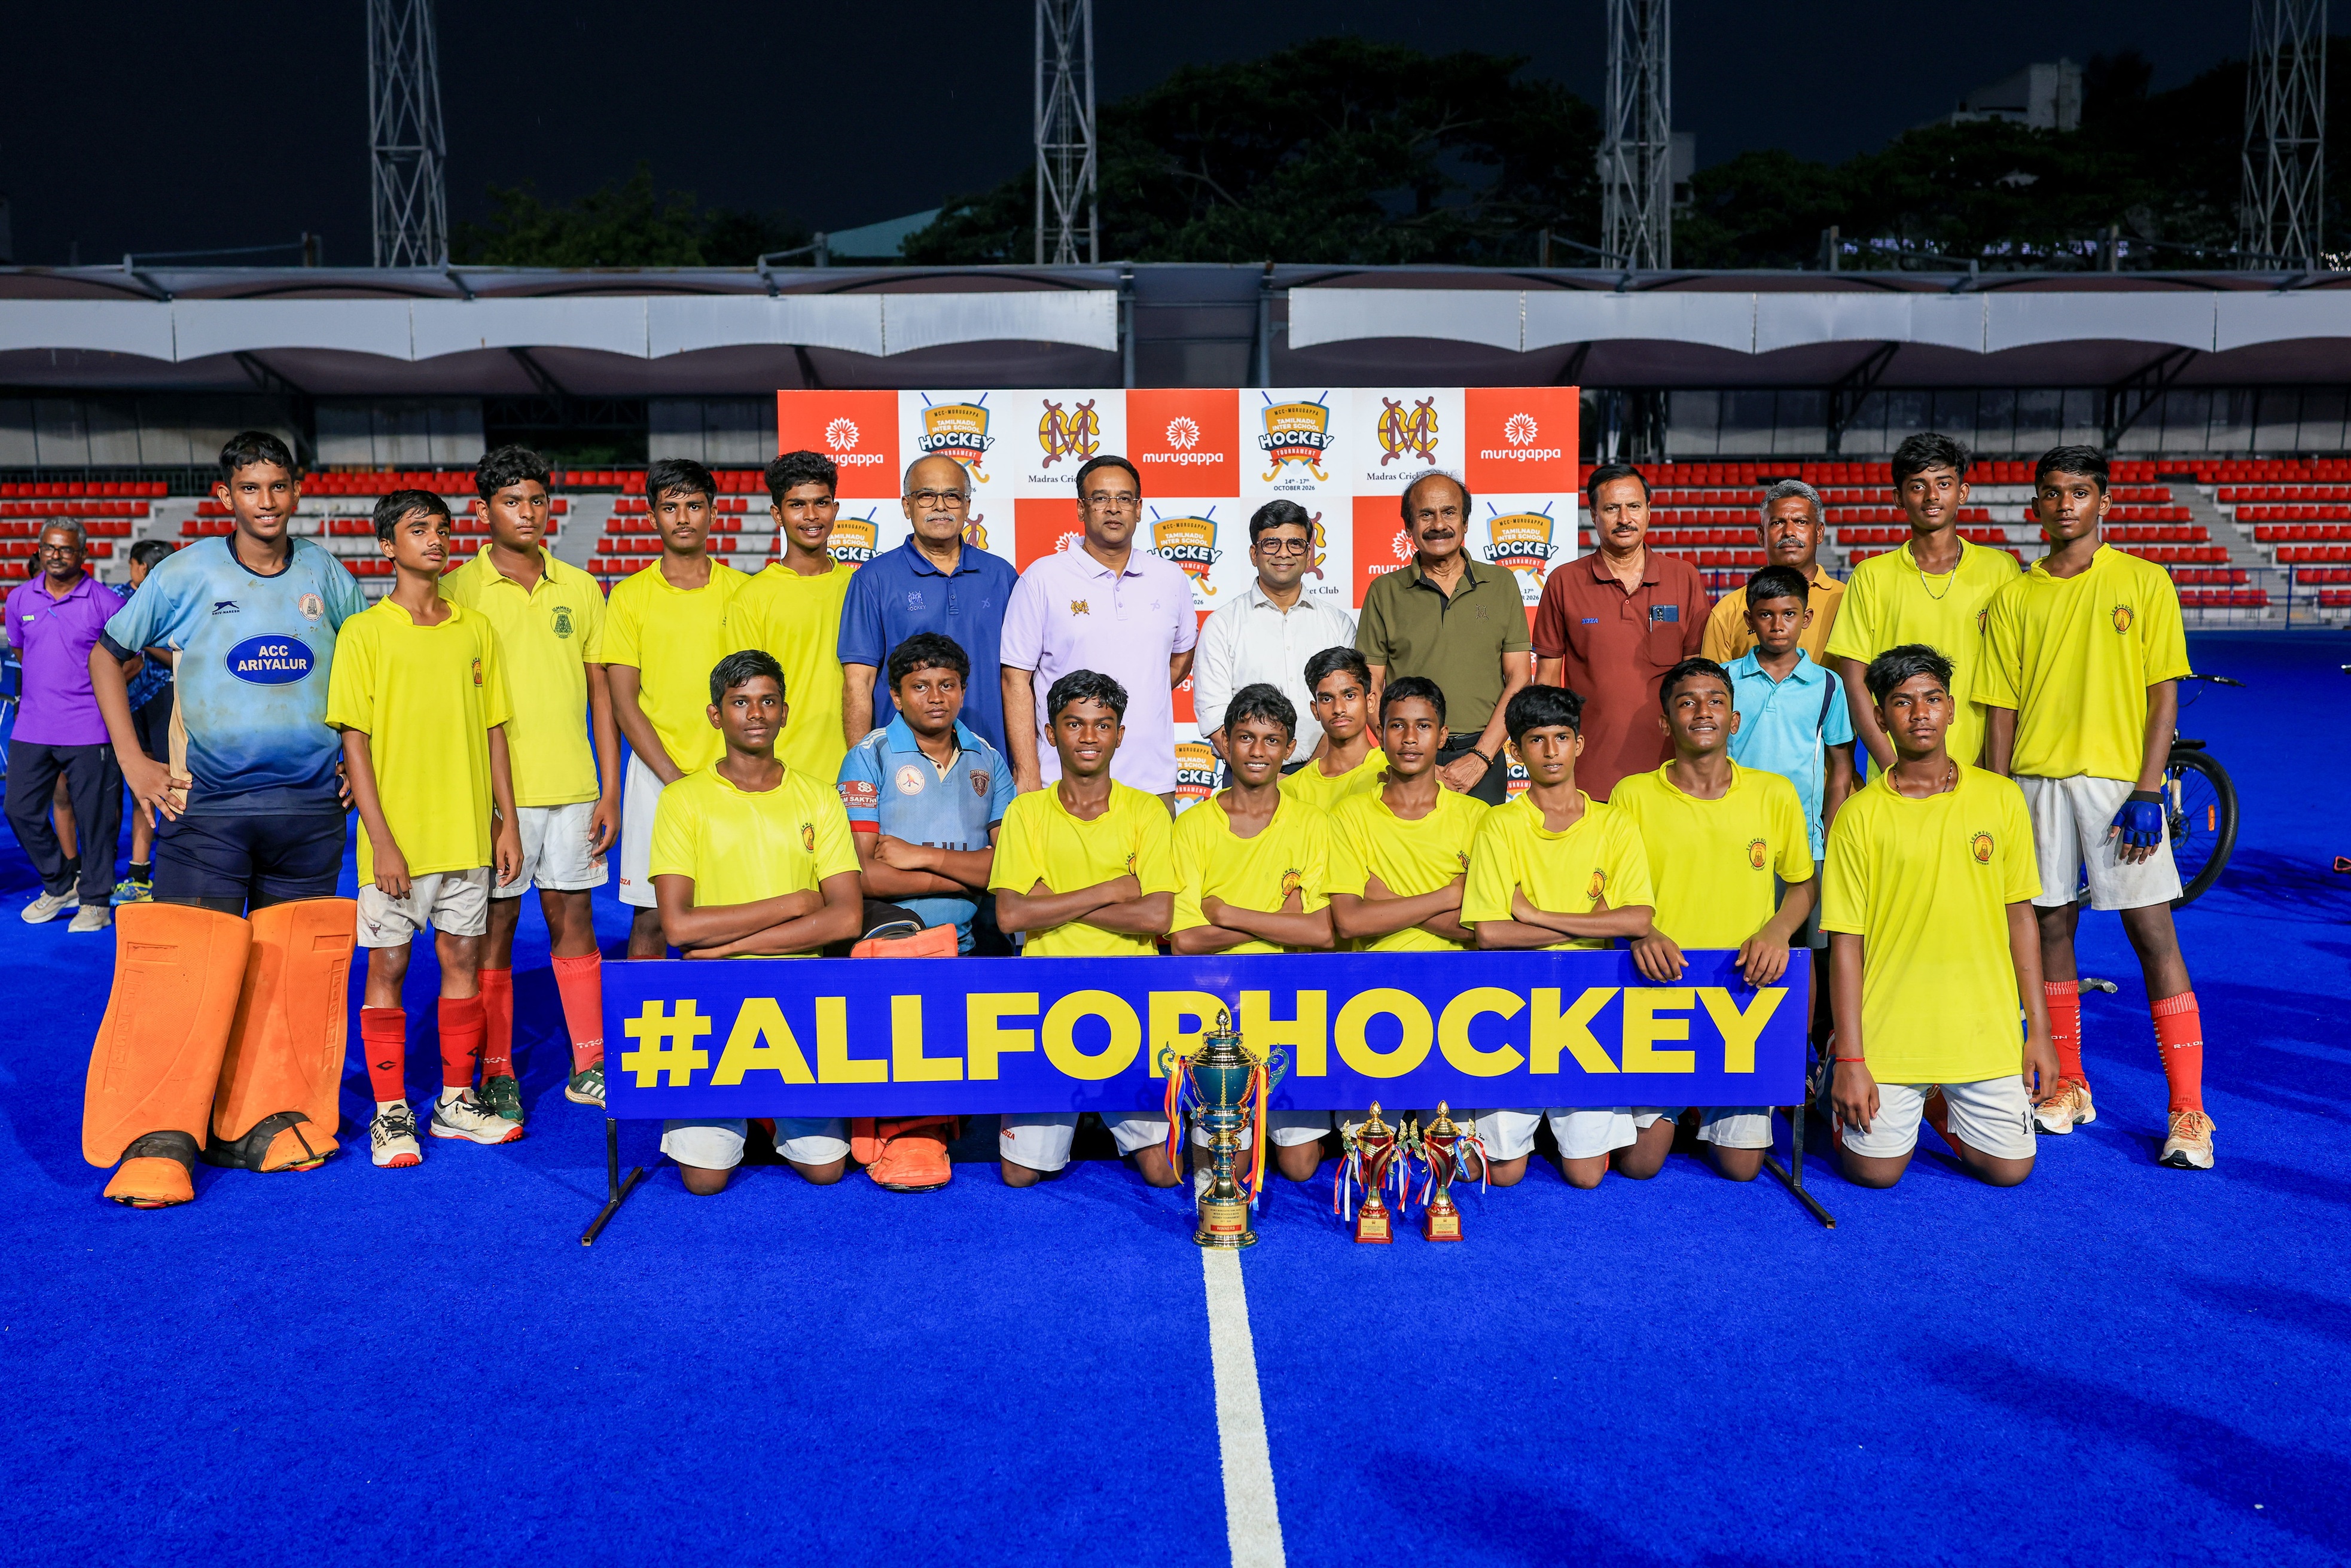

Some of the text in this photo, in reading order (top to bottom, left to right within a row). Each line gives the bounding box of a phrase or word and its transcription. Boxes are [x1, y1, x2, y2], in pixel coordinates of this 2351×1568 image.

[934, 409, 979, 417] MCC-MURUGAPPA
[953, 425, 980, 433] SCHOOL
[919, 432, 995, 450] HOCKEY
[1258, 431, 1334, 449] HOCKEY
[825, 454, 884, 467] rugappa
[1142, 453, 1224, 466] murugappa
[1481, 449, 1561, 462] murugappa
[1163, 522, 1207, 530] MCC-MURUGAPPA
[1499, 518, 1544, 526] MCC-MURUGAPPA
[827, 547, 884, 561] OCKEY
[1484, 541, 1559, 560] HOCKEY
[258, 645, 288, 657] ACC
[237, 659, 307, 672] ARIYALUR
[1177, 770, 1224, 787] CKEY
[371, 1127, 386, 1148] JUST
